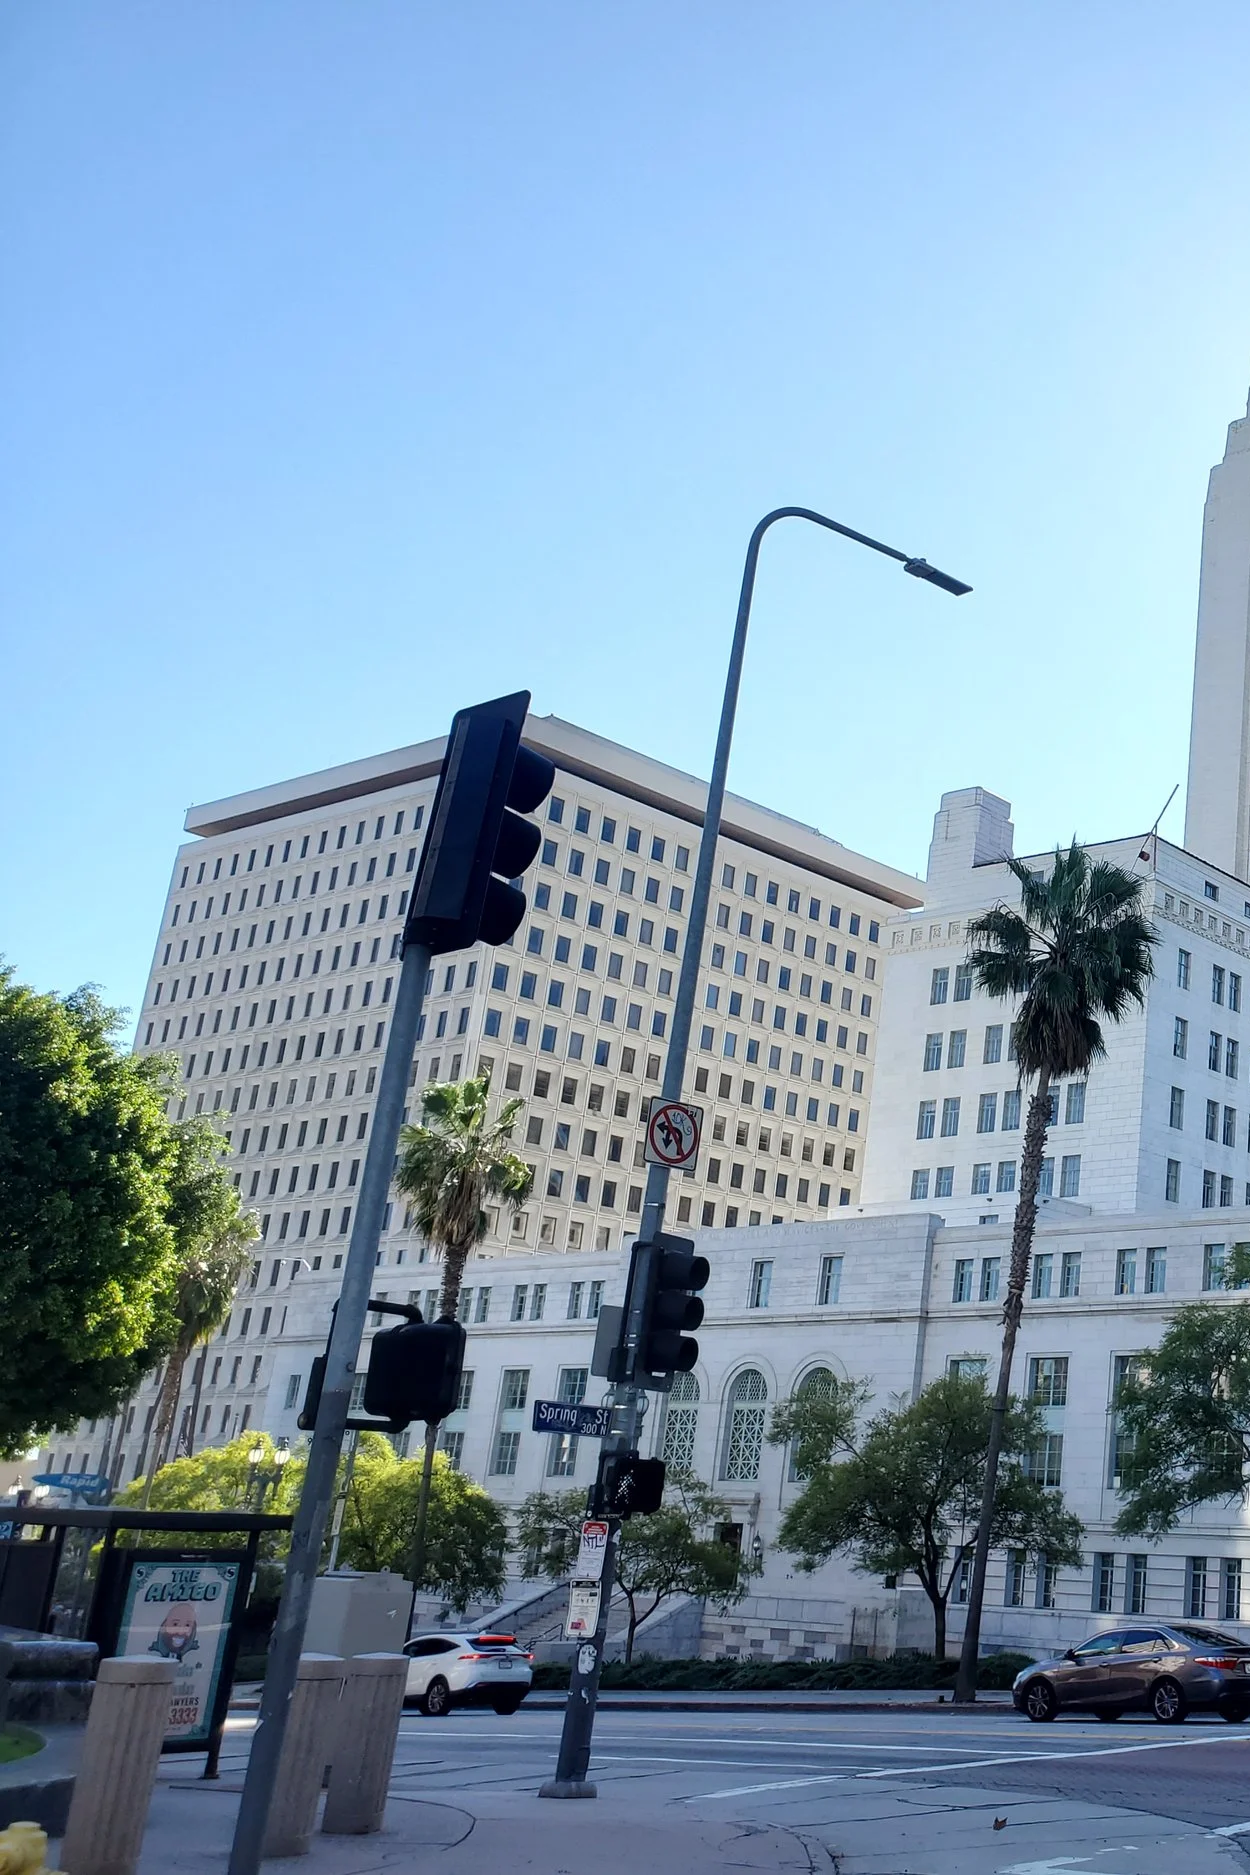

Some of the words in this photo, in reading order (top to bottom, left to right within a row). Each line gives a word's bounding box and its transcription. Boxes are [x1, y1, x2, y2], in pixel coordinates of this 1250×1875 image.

[539, 1403, 578, 1427] Spring
[595, 1409, 609, 1425] St
[580, 1423, 597, 1434] 300
[600, 1425, 607, 1435] N
[60, 1475, 100, 1488] Rapid
[172, 1569, 202, 1582] THE
[144, 1581, 222, 1602] AMIGO
